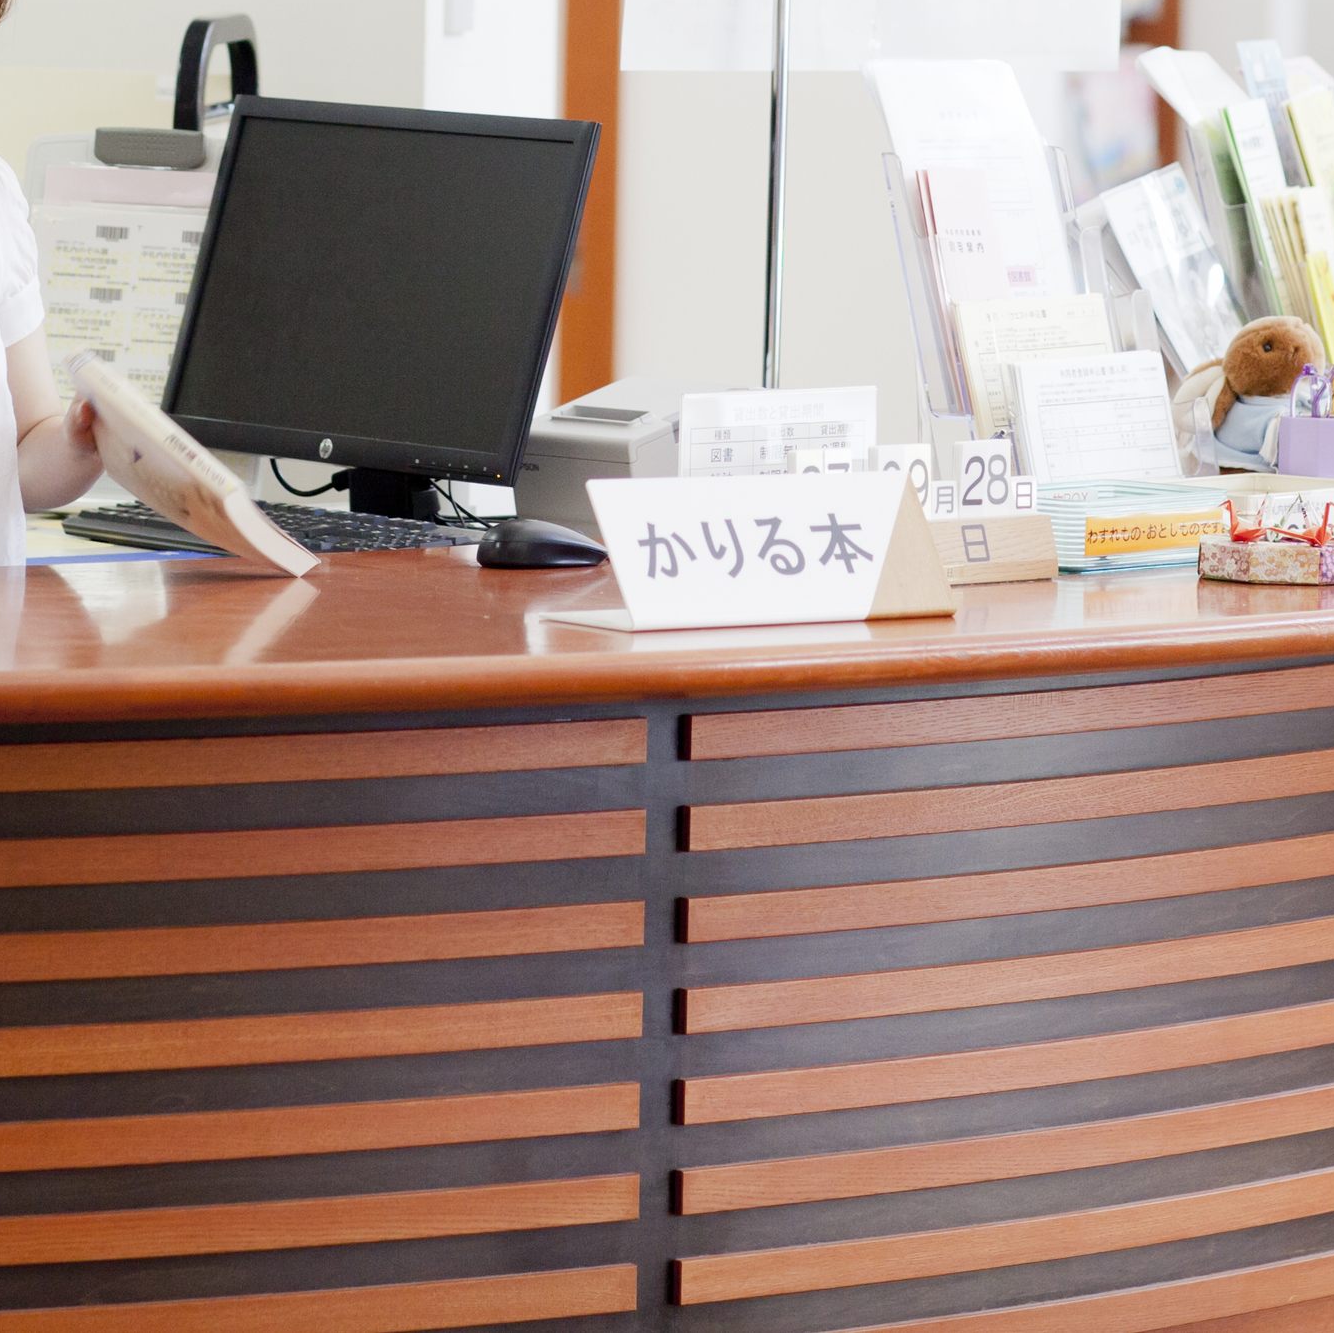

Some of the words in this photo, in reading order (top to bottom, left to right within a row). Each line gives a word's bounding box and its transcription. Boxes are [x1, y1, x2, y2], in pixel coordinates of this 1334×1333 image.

[733, 402, 824, 422] 貸出数と貸出期間
[820, 423, 854, 436] 貸出期間
[710, 447, 734, 463] 図書
[519, 462, 540, 472] PSON
[935, 485, 955, 514] 月
[961, 453, 1009, 507] 28
[1016, 481, 1033, 510] 日
[960, 523, 991, 563] 日
[1086, 521, 1227, 545] わすれもの・おとしものです。
[637, 512, 875, 580] かりる本
